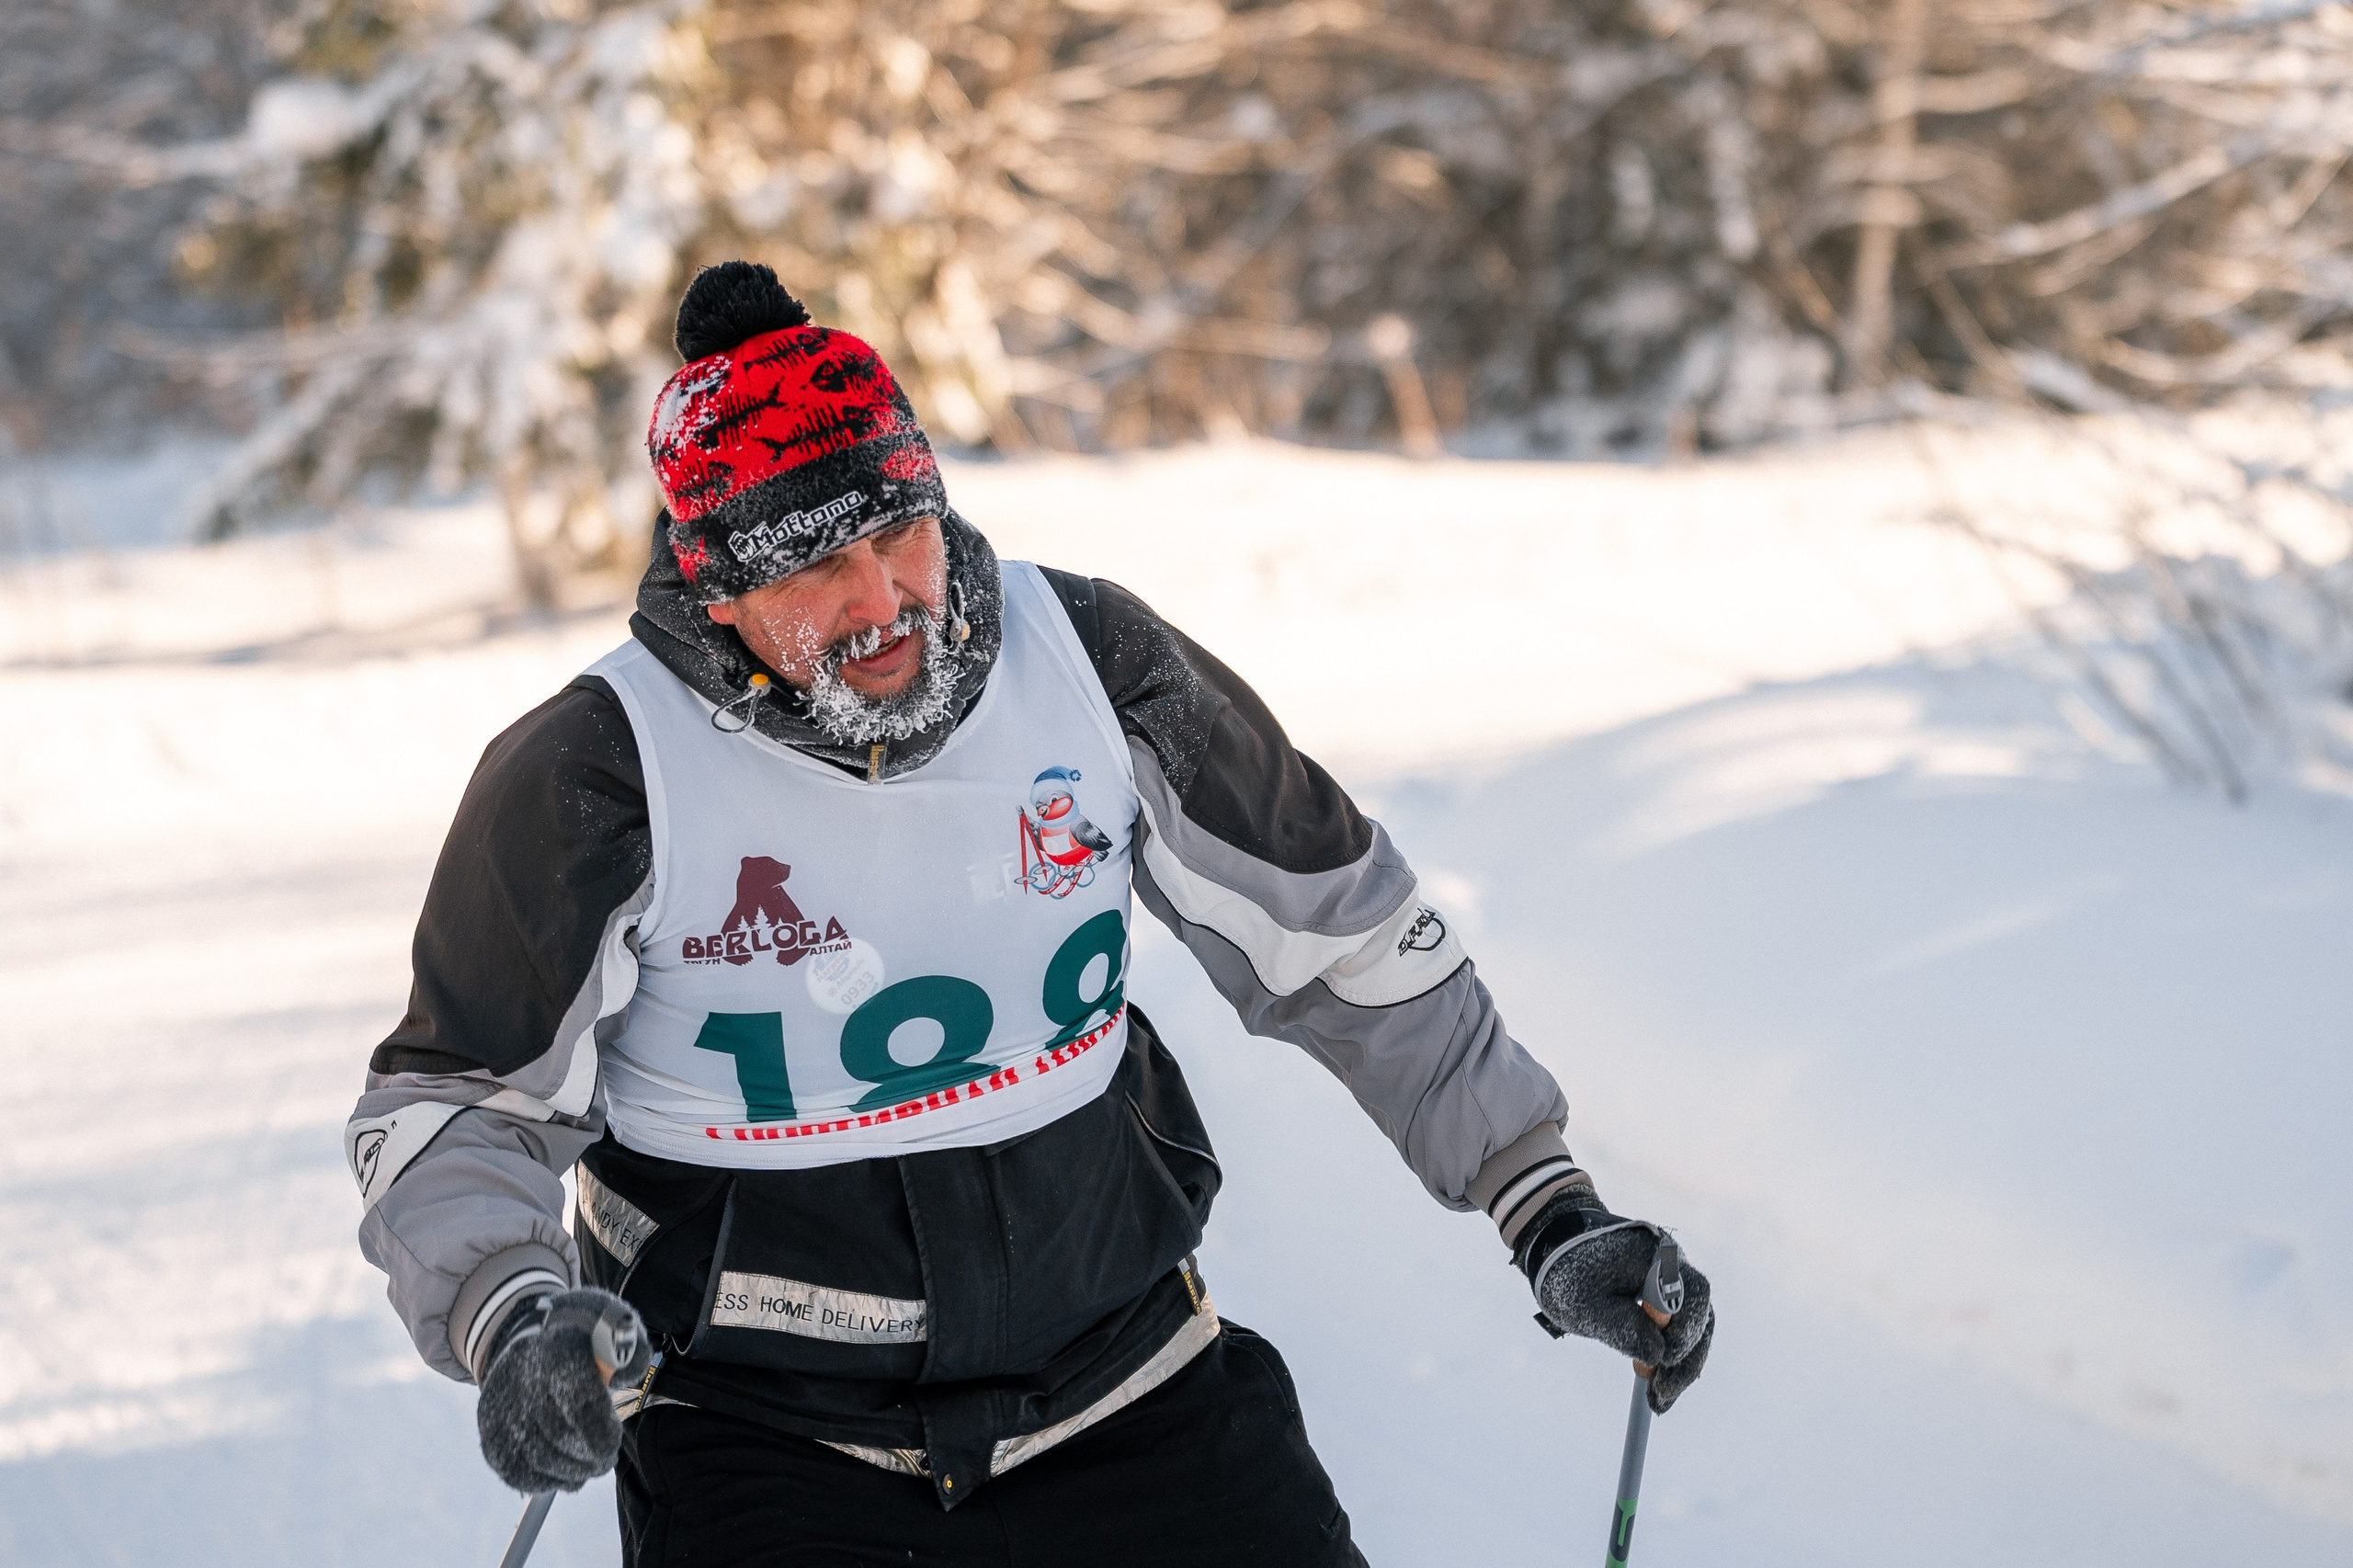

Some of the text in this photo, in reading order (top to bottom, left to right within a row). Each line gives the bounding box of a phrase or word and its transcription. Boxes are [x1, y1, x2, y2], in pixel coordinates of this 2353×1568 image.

[682, 915, 850, 959] BERLOGA
[810, 939, 852, 956] АЛТАЙ
[840, 971, 875, 1006] 0933
[620, 1228, 643, 1253] EX
[760, 1295, 814, 1322] HOME
[821, 1307, 925, 1334] DELIVERY
